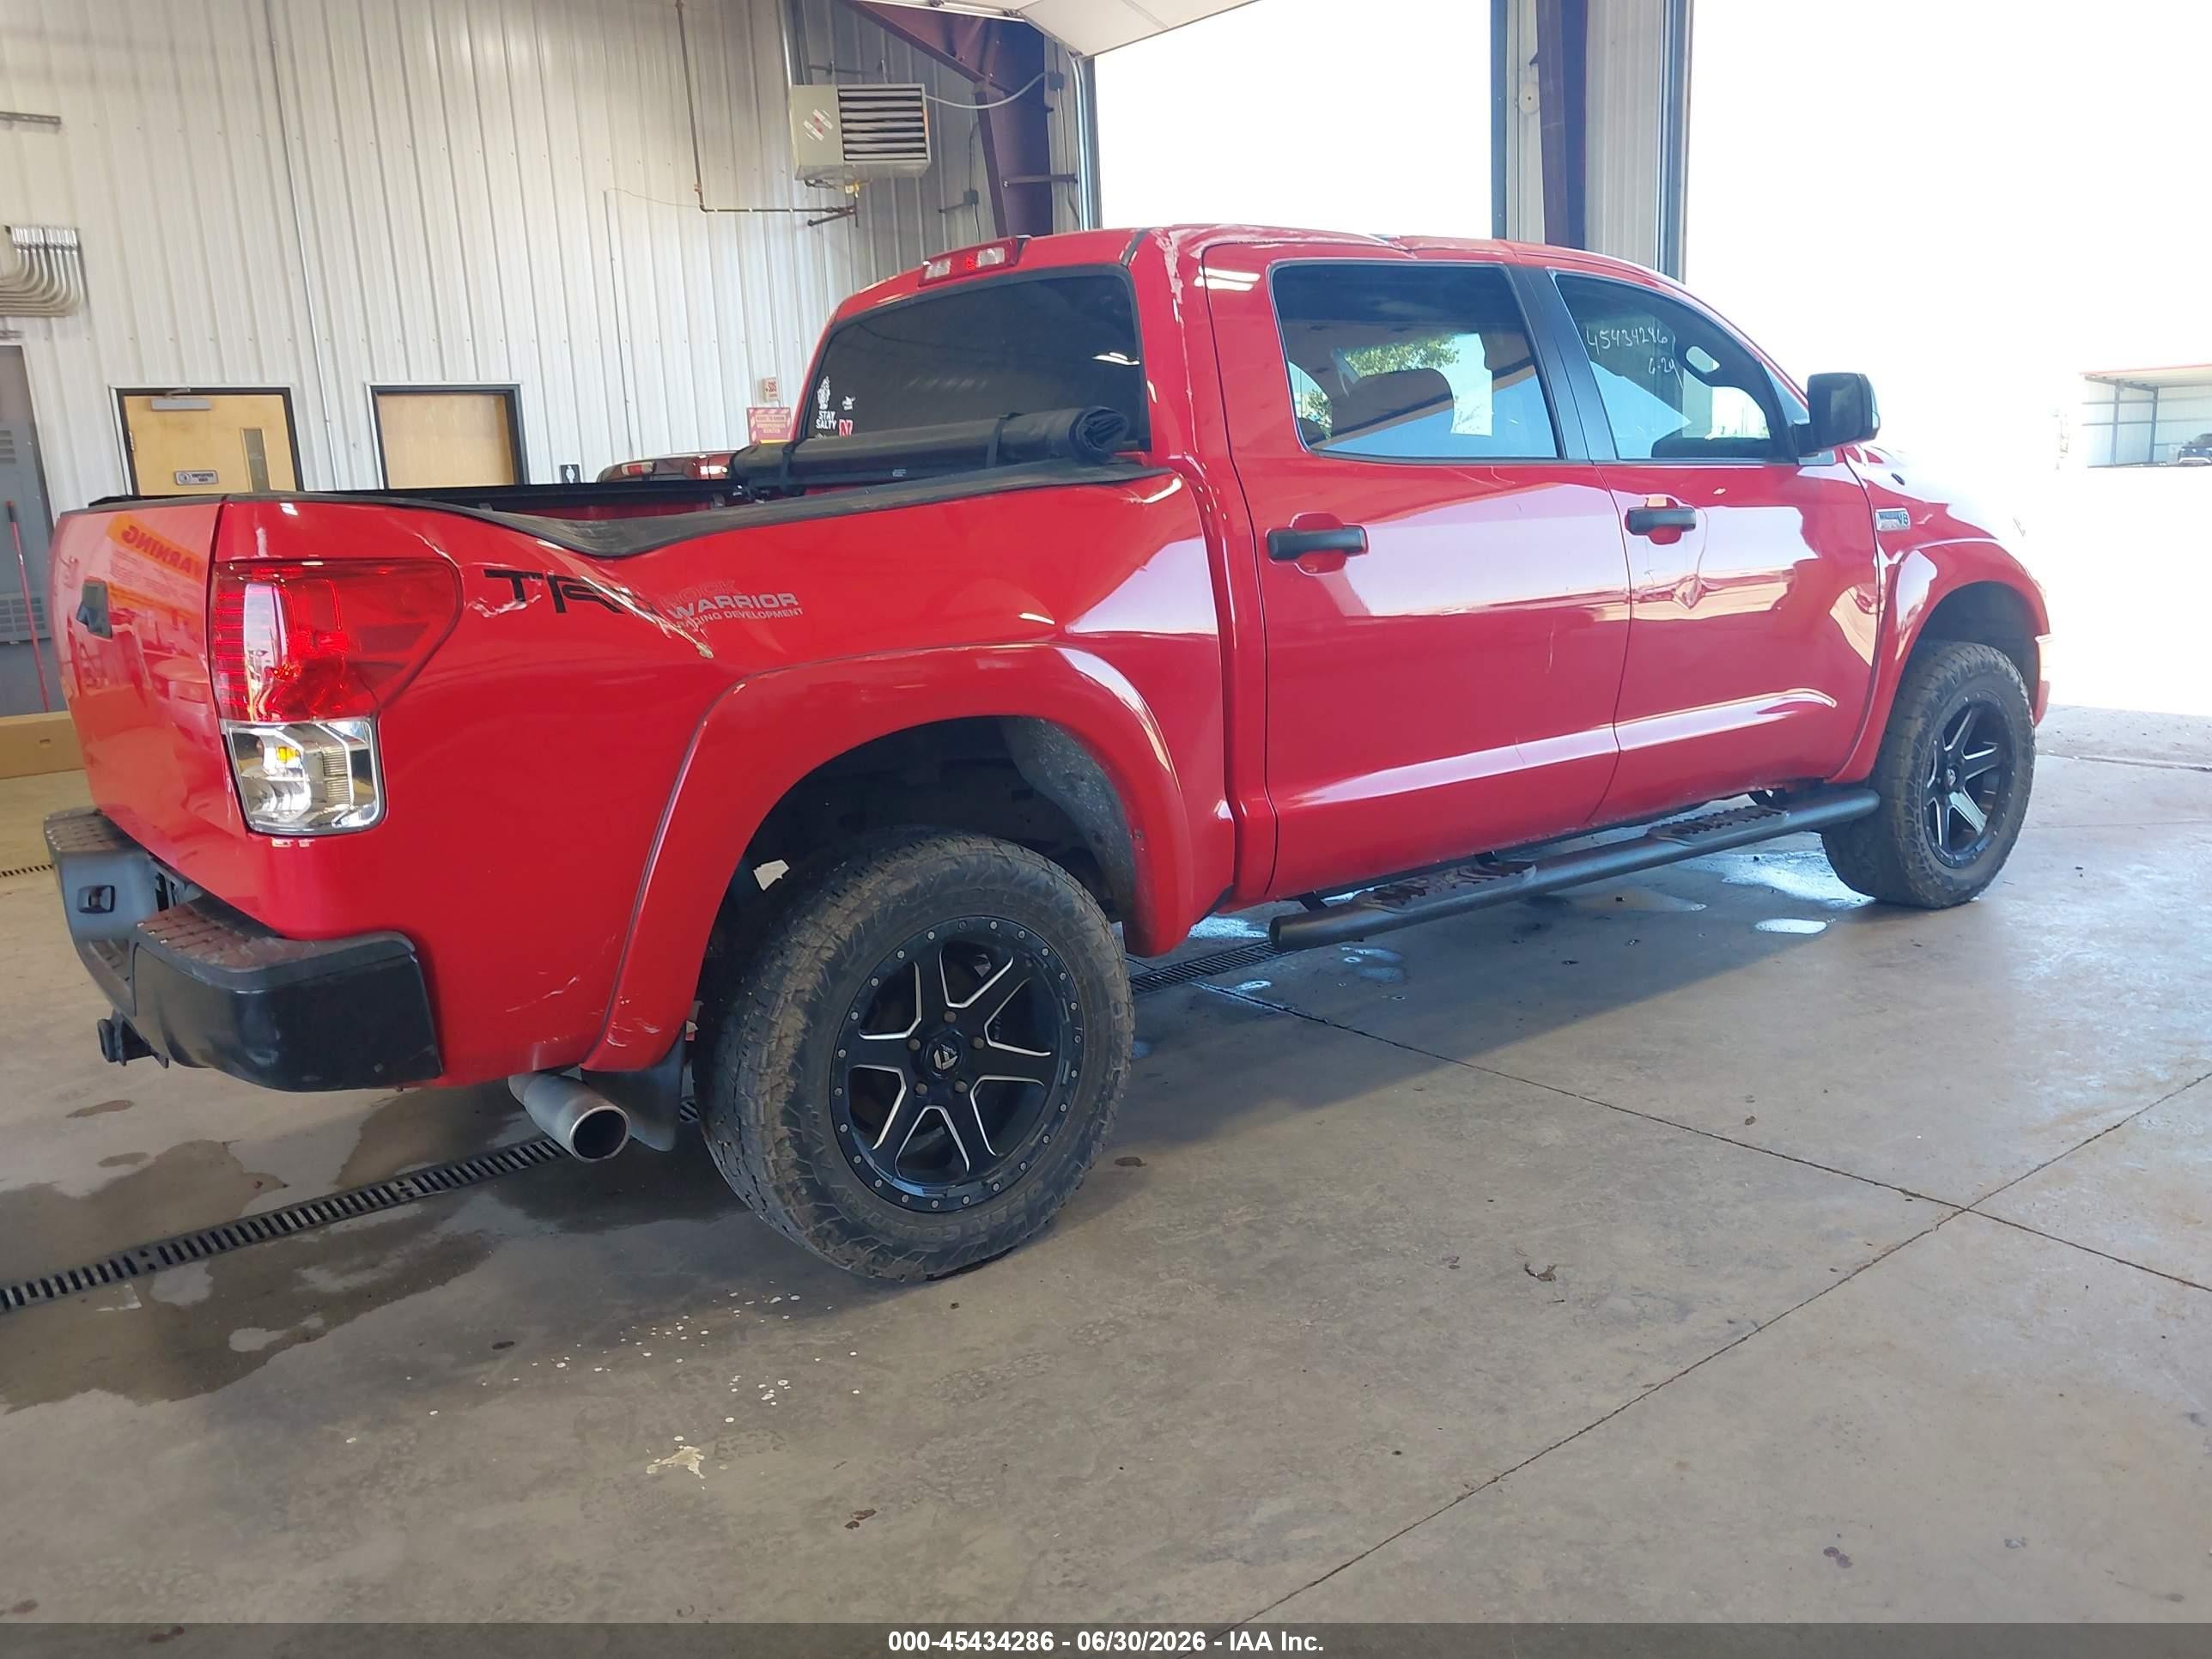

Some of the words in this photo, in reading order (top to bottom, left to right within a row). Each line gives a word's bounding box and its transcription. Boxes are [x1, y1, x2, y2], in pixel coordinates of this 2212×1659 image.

[818, 410, 836, 420] STAY
[815, 418, 837, 430] SALTY
[483, 568, 627, 615] TR
[665, 592, 799, 620] WARRIOR
[723, 607, 804, 620] DEVELOPMENT
